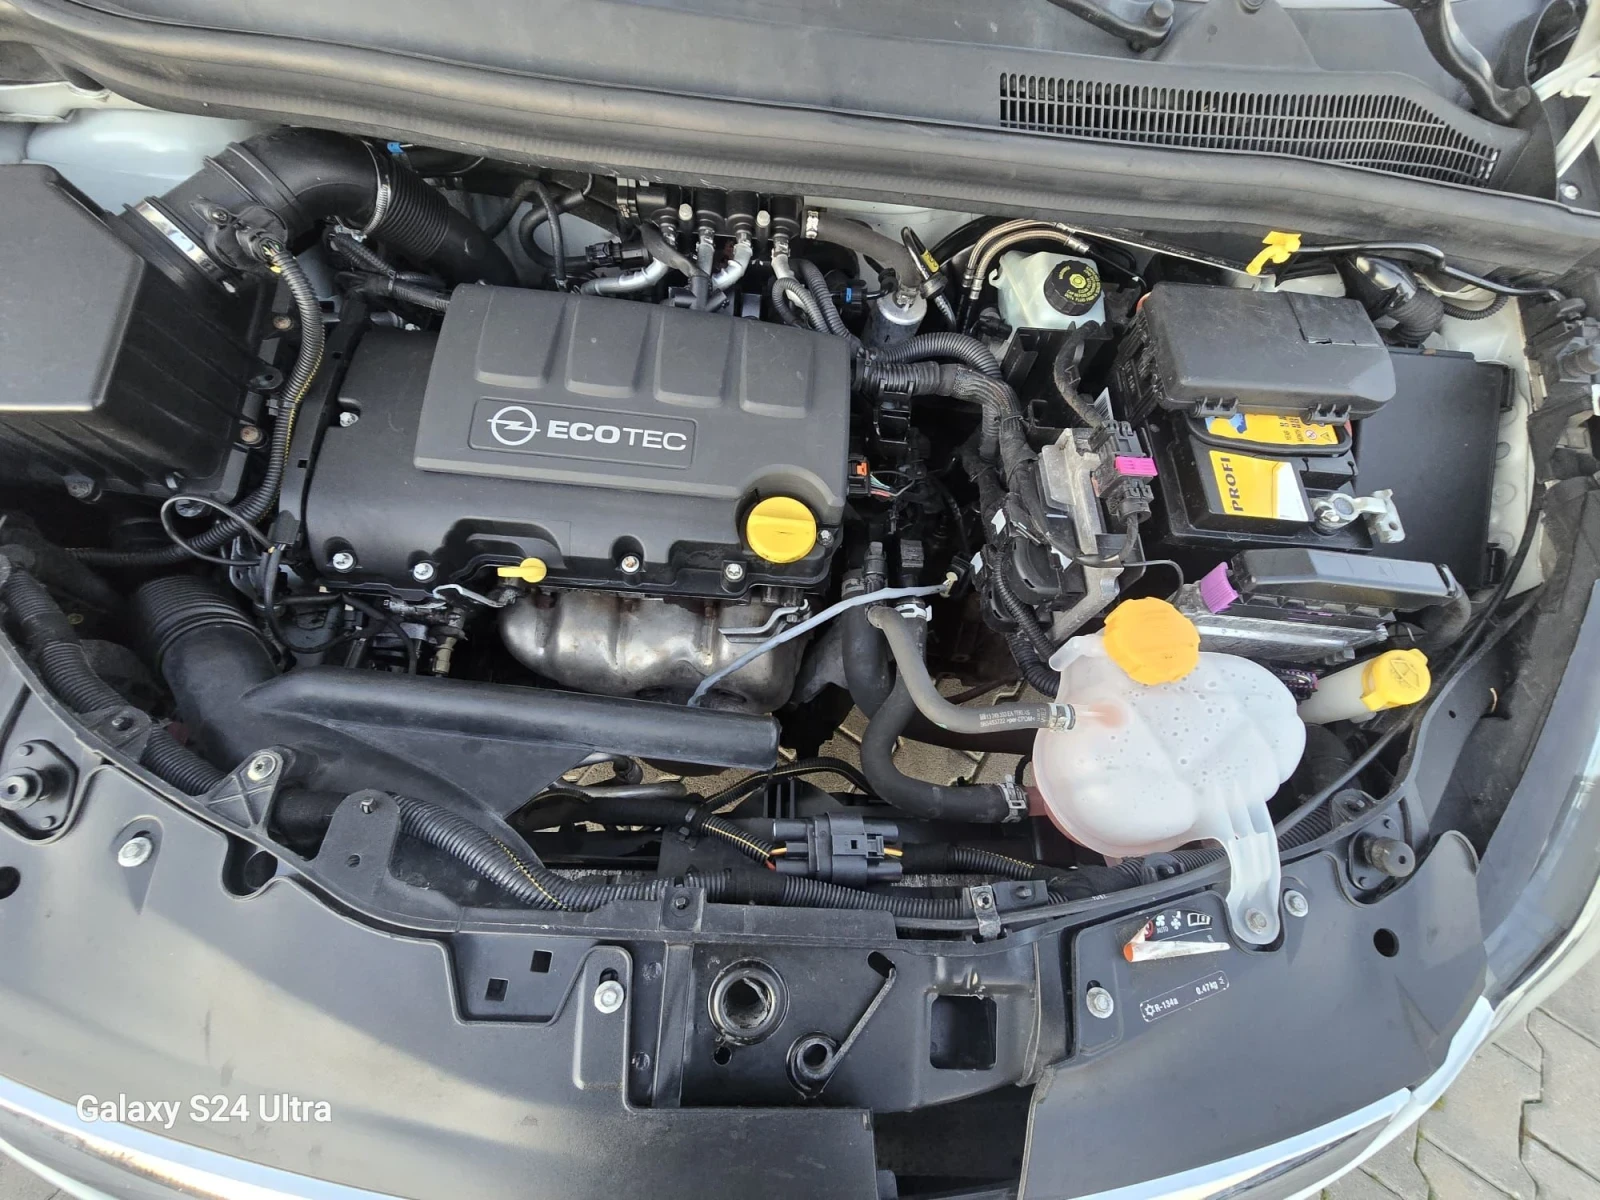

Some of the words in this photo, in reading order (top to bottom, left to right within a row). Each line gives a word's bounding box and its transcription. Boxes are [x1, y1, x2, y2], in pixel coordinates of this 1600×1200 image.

[547, 419, 687, 451] ECOTEC
[1220, 457, 1244, 512] PROFI
[1154, 997, 1179, 1013] R-134a
